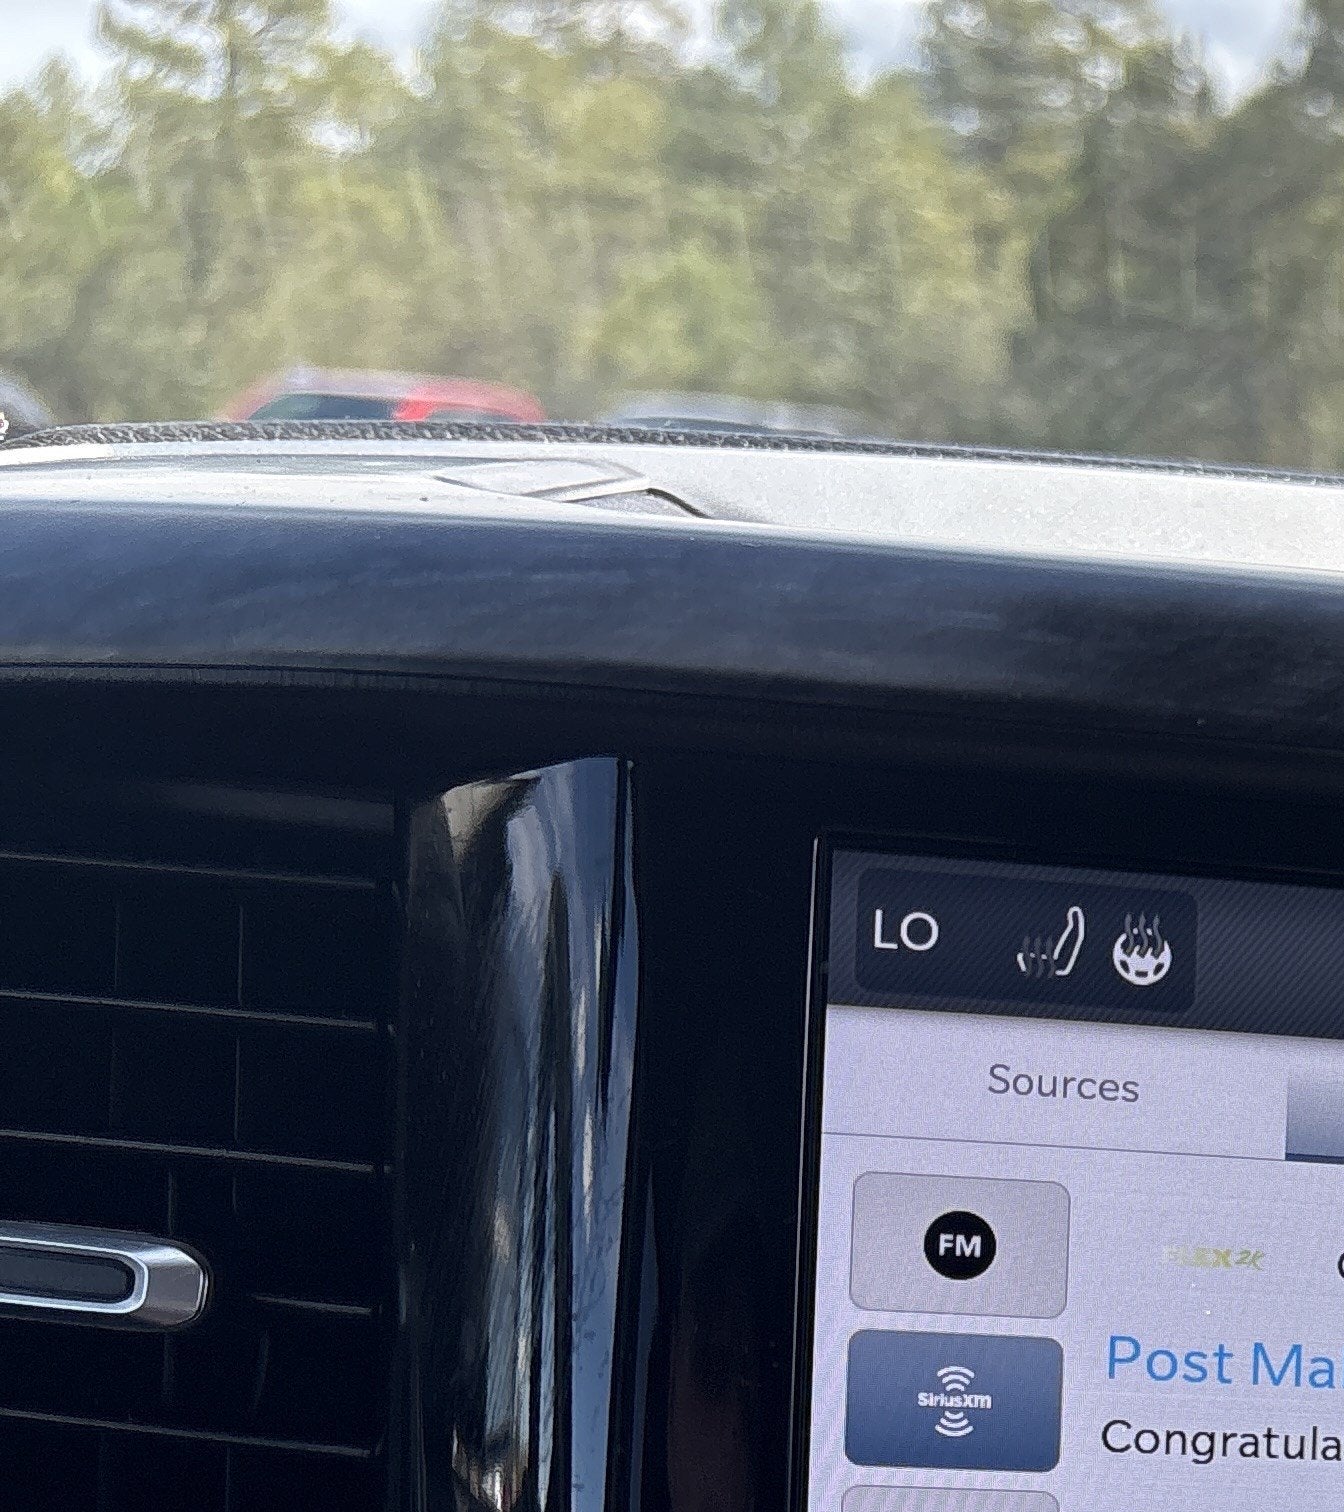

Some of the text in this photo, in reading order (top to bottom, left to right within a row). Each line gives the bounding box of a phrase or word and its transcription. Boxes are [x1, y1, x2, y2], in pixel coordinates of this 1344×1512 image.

[873, 908, 939, 951] LO
[987, 1063, 1140, 1103] Sources
[938, 1233, 982, 1258] FM
[1108, 1335, 1234, 1385] Post
